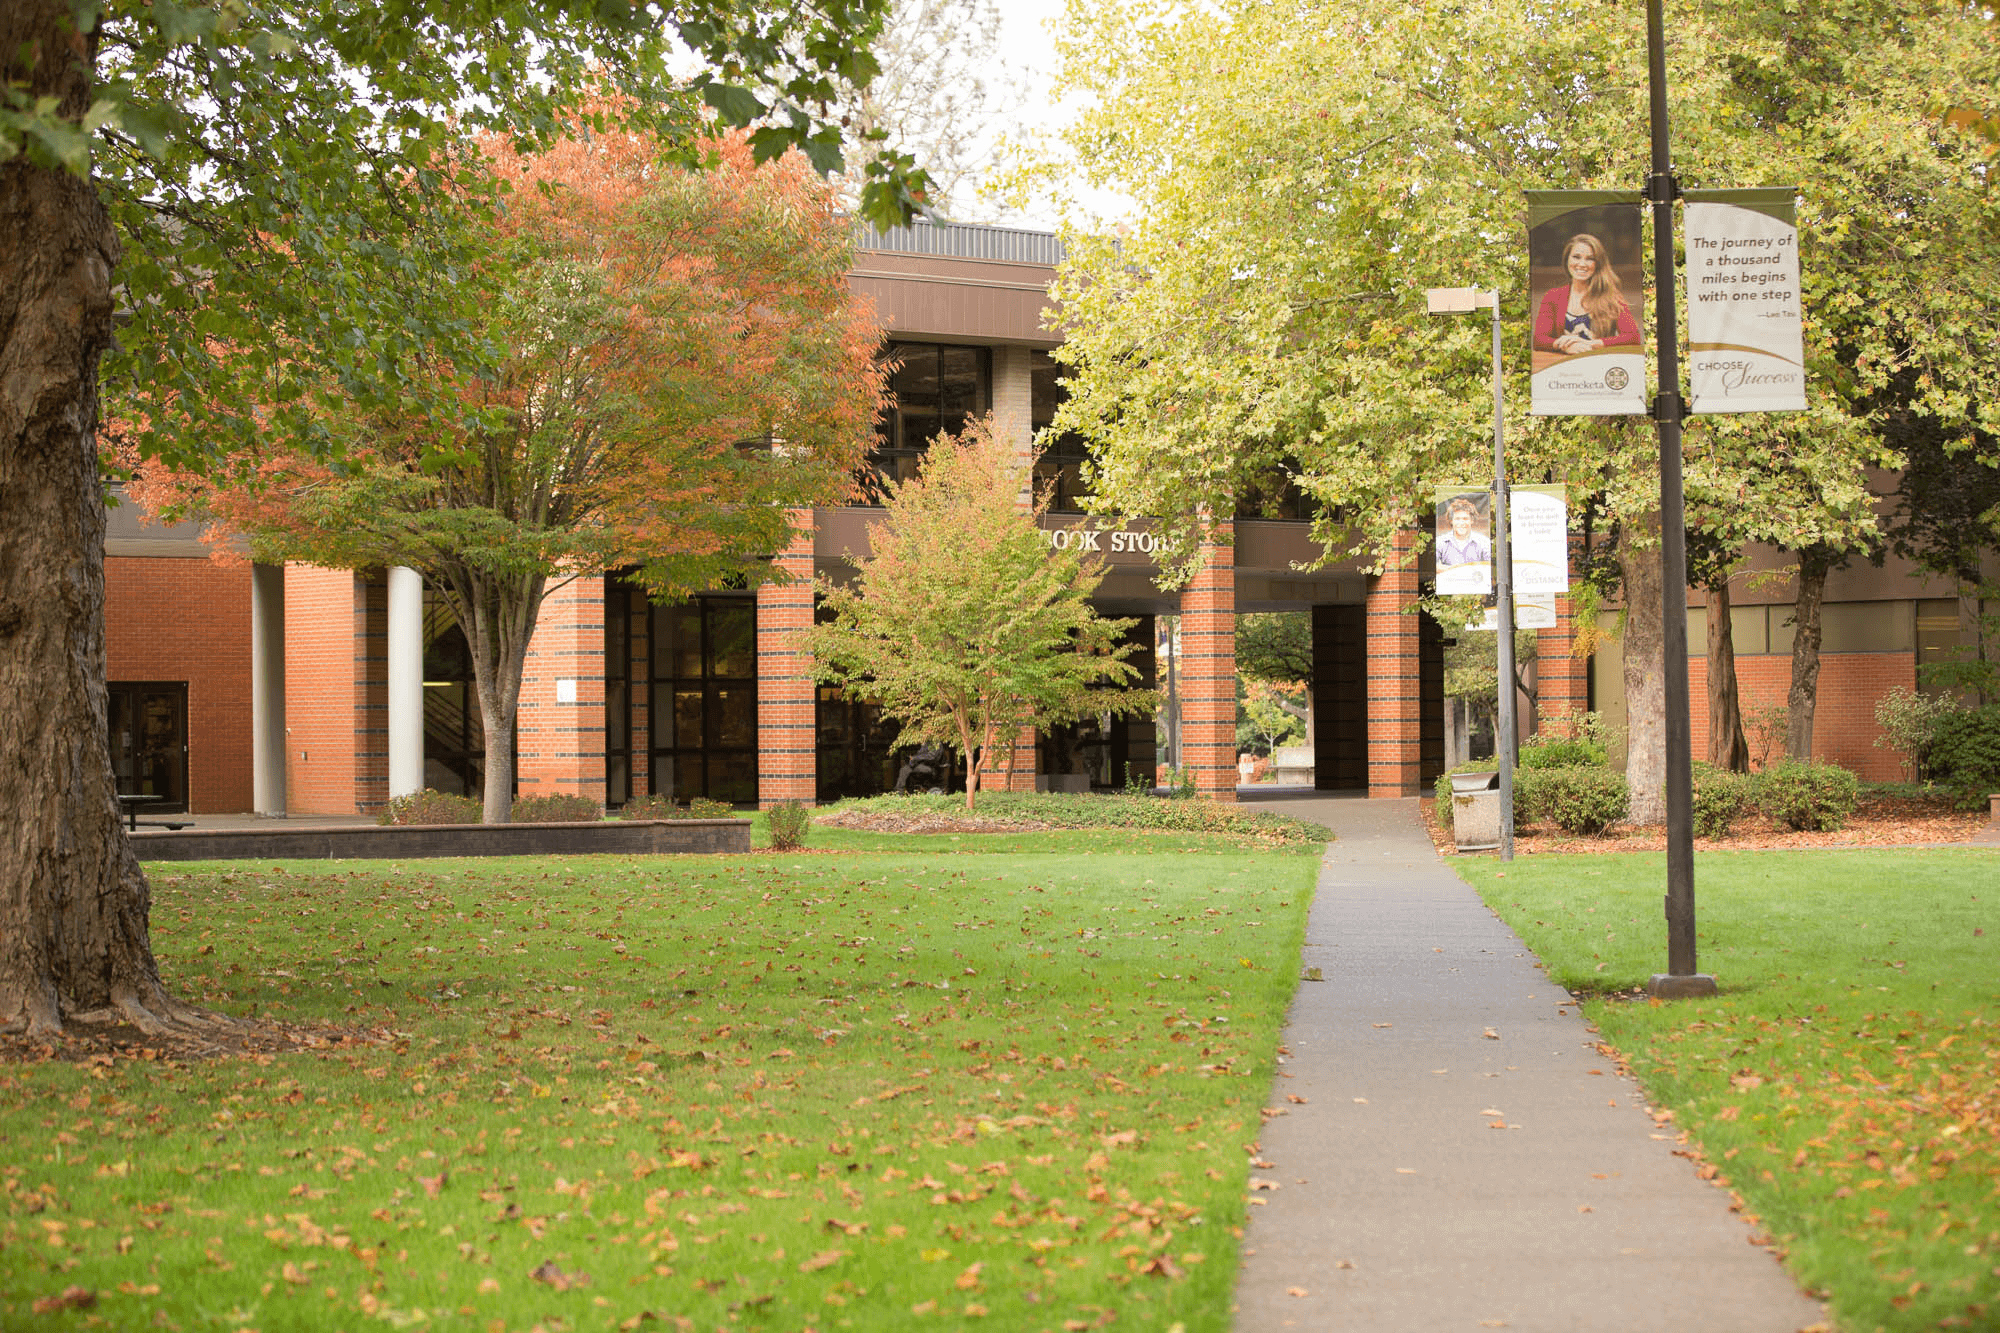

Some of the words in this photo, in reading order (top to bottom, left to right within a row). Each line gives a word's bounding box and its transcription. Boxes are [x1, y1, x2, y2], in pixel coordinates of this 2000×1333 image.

[1693, 237, 1718, 249] The
[1720, 237, 1773, 251] journey
[1777, 234, 1793, 246] of
[1705, 258, 1714, 266] a
[1718, 252, 1781, 266] thousand
[1701, 272, 1737, 284] miles
[1741, 271, 1787, 286] begins
[1698, 290, 1728, 302] with
[1732, 292, 1758, 301] one
[1761, 290, 1792, 302] step
[1547, 380, 1605, 390] Chemeketa
[1697, 361, 1743, 371] CHOOSE
[1721, 361, 1798, 397] Success
